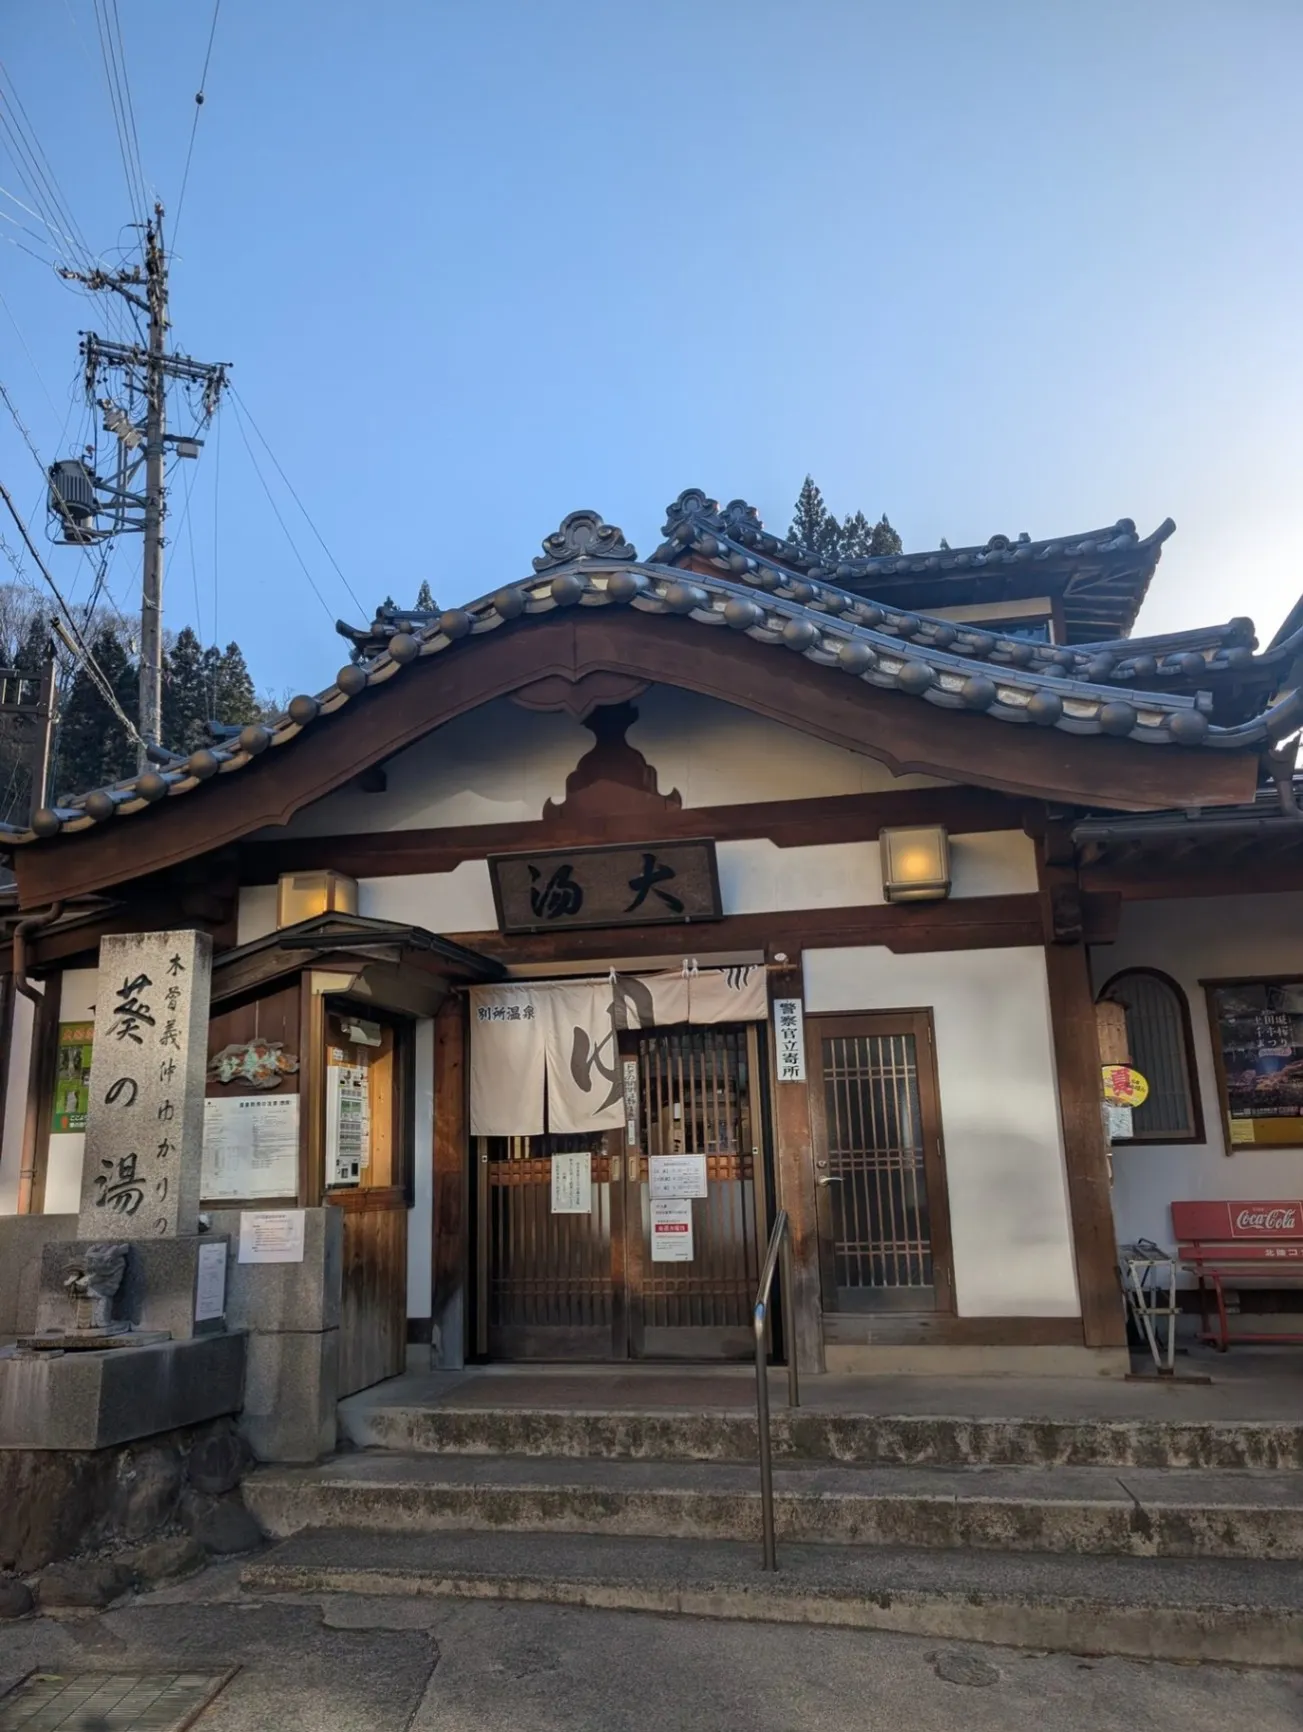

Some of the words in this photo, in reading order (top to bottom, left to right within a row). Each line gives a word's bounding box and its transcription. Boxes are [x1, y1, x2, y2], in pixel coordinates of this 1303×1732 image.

[478, 1006, 536, 1021] 別所温泉
[570, 975, 656, 1117] ゆ
[779, 1002, 800, 1077] 警察官立寄所
[94, 973, 156, 1216] 葵の湯
[1236, 1208, 1297, 1230] Coca-Cola
[1265, 1248, 1303, 1257] 北陸コ
